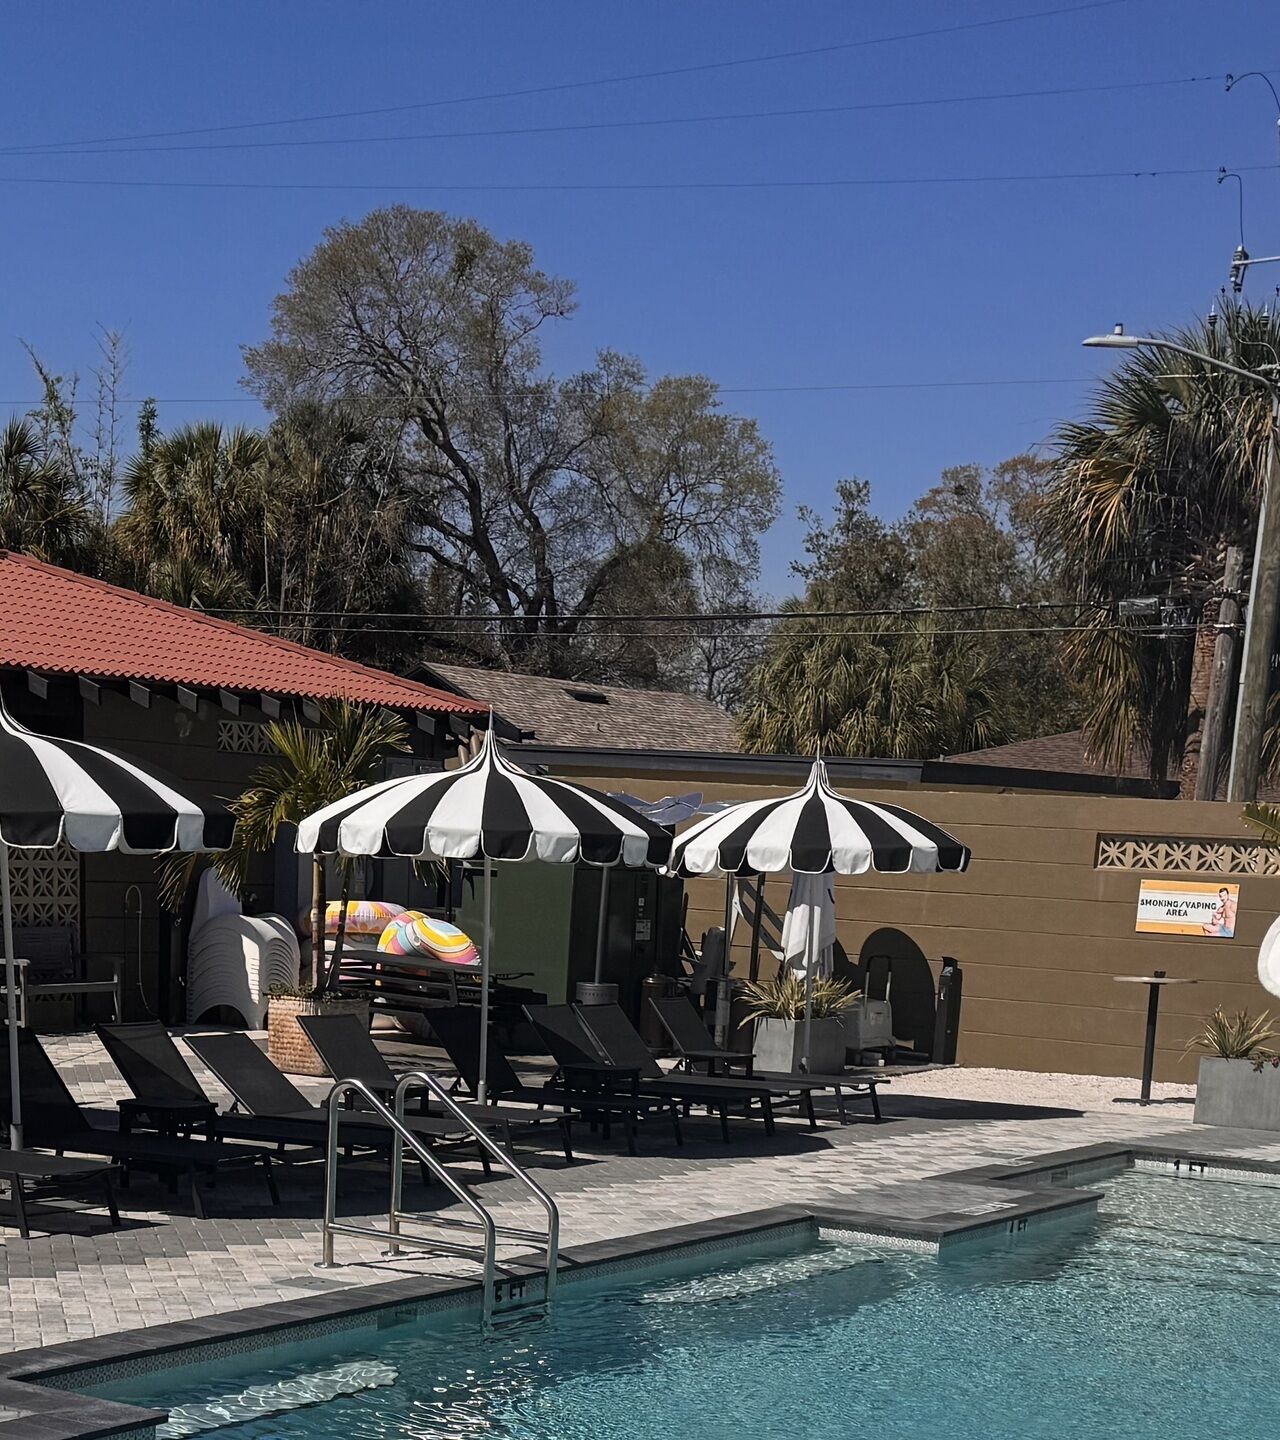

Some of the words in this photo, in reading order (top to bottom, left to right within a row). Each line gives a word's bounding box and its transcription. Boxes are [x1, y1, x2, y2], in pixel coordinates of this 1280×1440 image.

[1140, 899, 1217, 909] SMOKING/VAPING
[1166, 908, 1188, 917] AREA
[510, 1281, 526, 1300] FT
